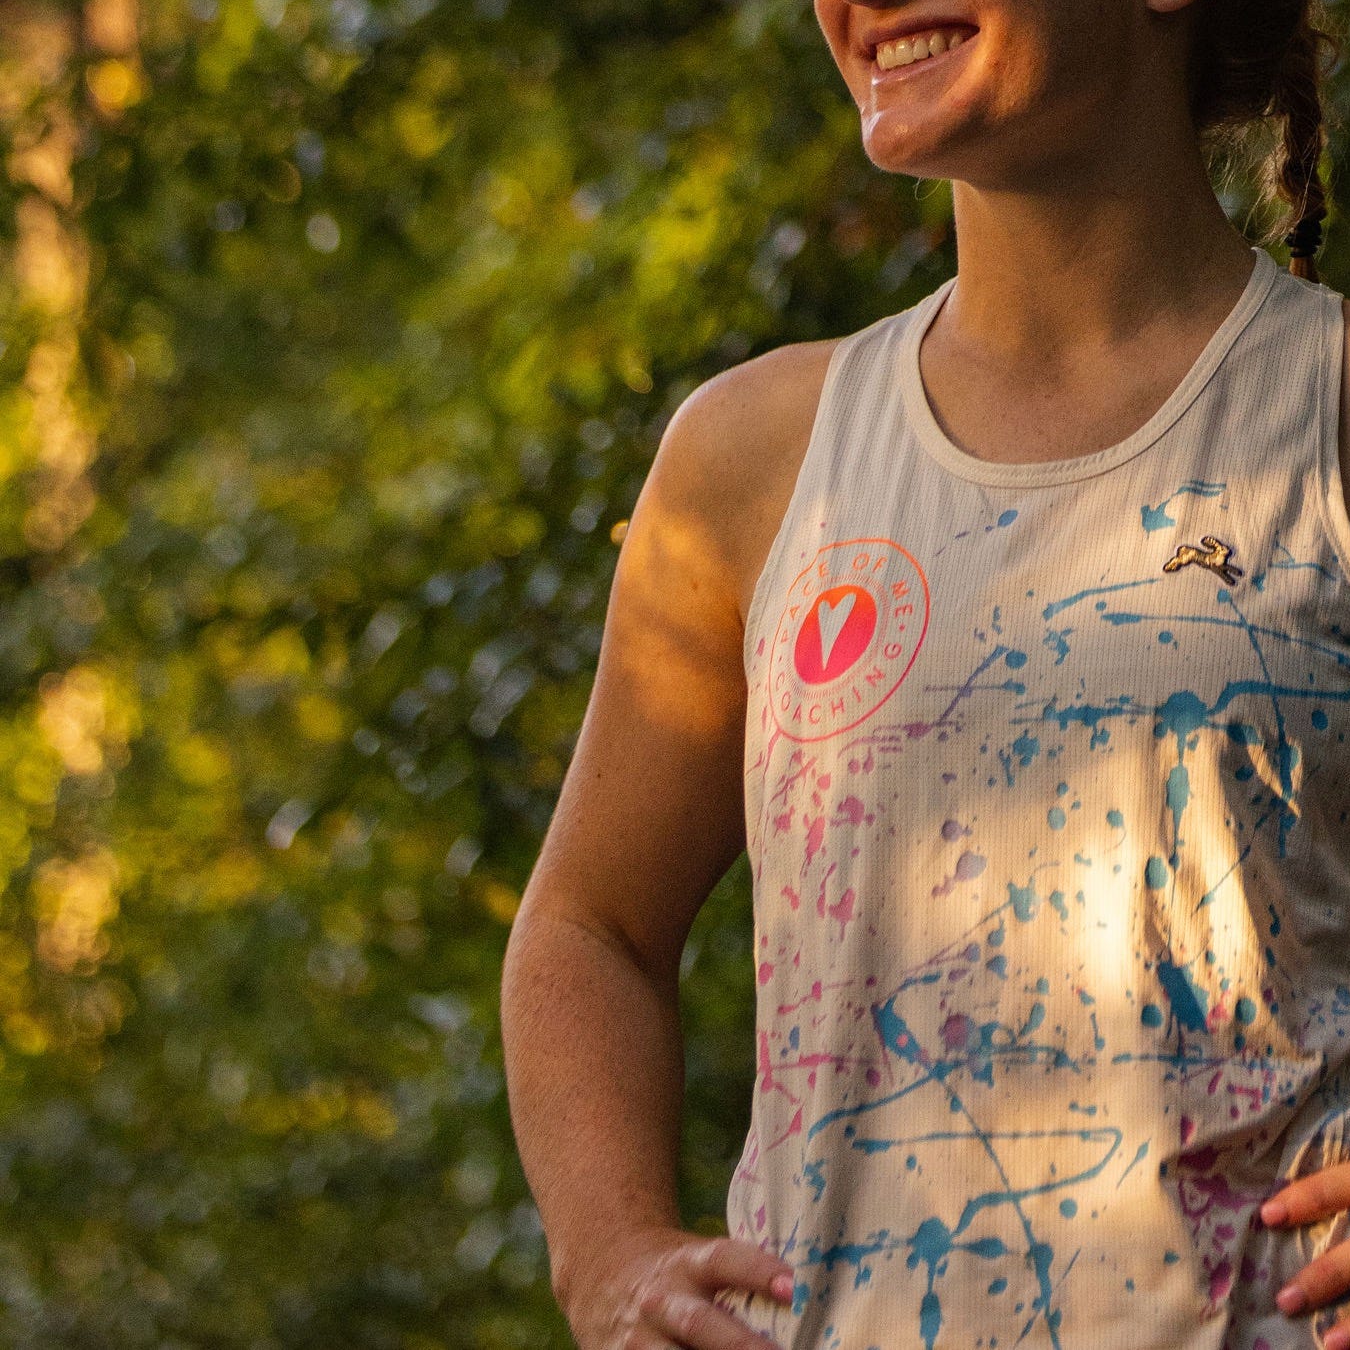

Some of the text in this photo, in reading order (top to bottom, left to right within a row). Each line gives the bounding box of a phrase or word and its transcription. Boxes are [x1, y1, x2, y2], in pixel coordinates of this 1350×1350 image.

[780, 553, 913, 643] PACE OF ME
[775, 643, 902, 725] COACHING
